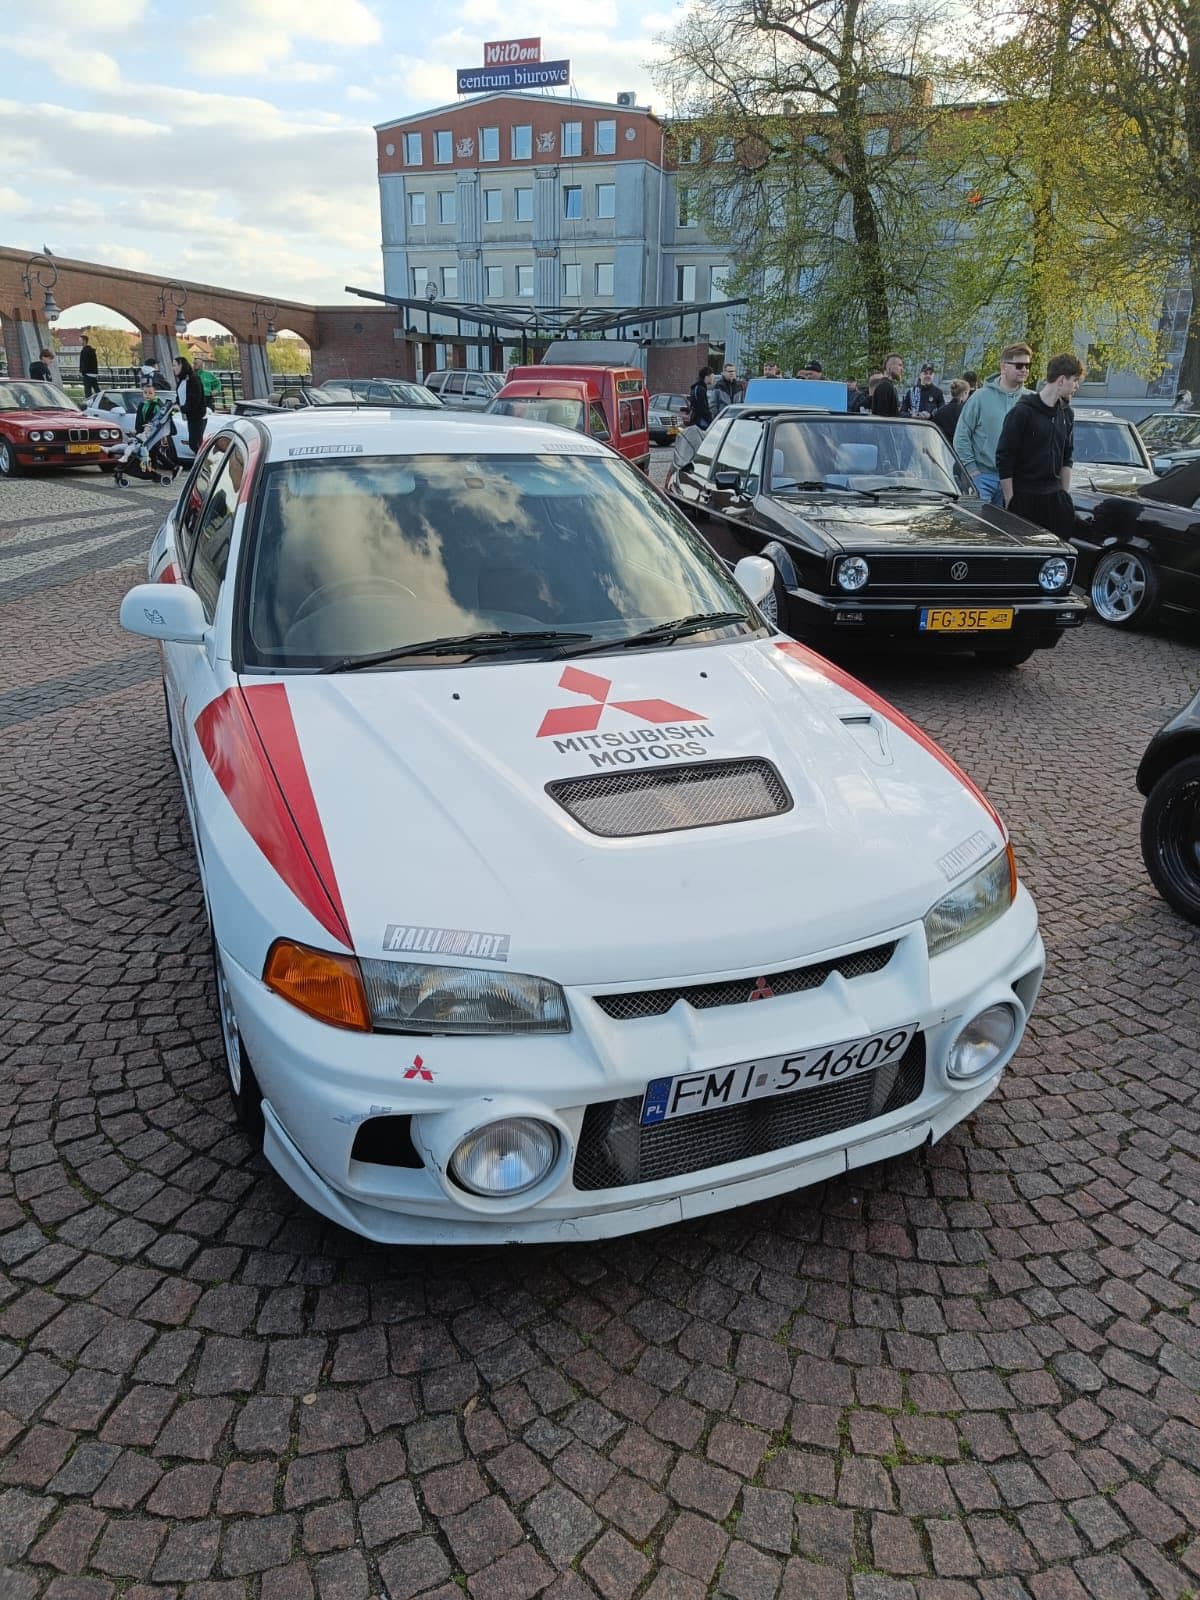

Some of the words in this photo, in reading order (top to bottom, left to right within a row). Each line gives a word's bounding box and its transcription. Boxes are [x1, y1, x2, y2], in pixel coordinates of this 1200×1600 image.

[487, 43, 539, 62] WilDom
[459, 74, 510, 89] centrum
[514, 68, 568, 85] biurowe
[930, 610, 952, 628] FG
[956, 610, 988, 628] 35E
[552, 724, 715, 754] MITSUBISHI
[588, 741, 708, 768] MOTORS
[670, 1064, 756, 1113] FMI
[774, 1030, 908, 1090] 54609
[646, 1104, 663, 1117] PL
